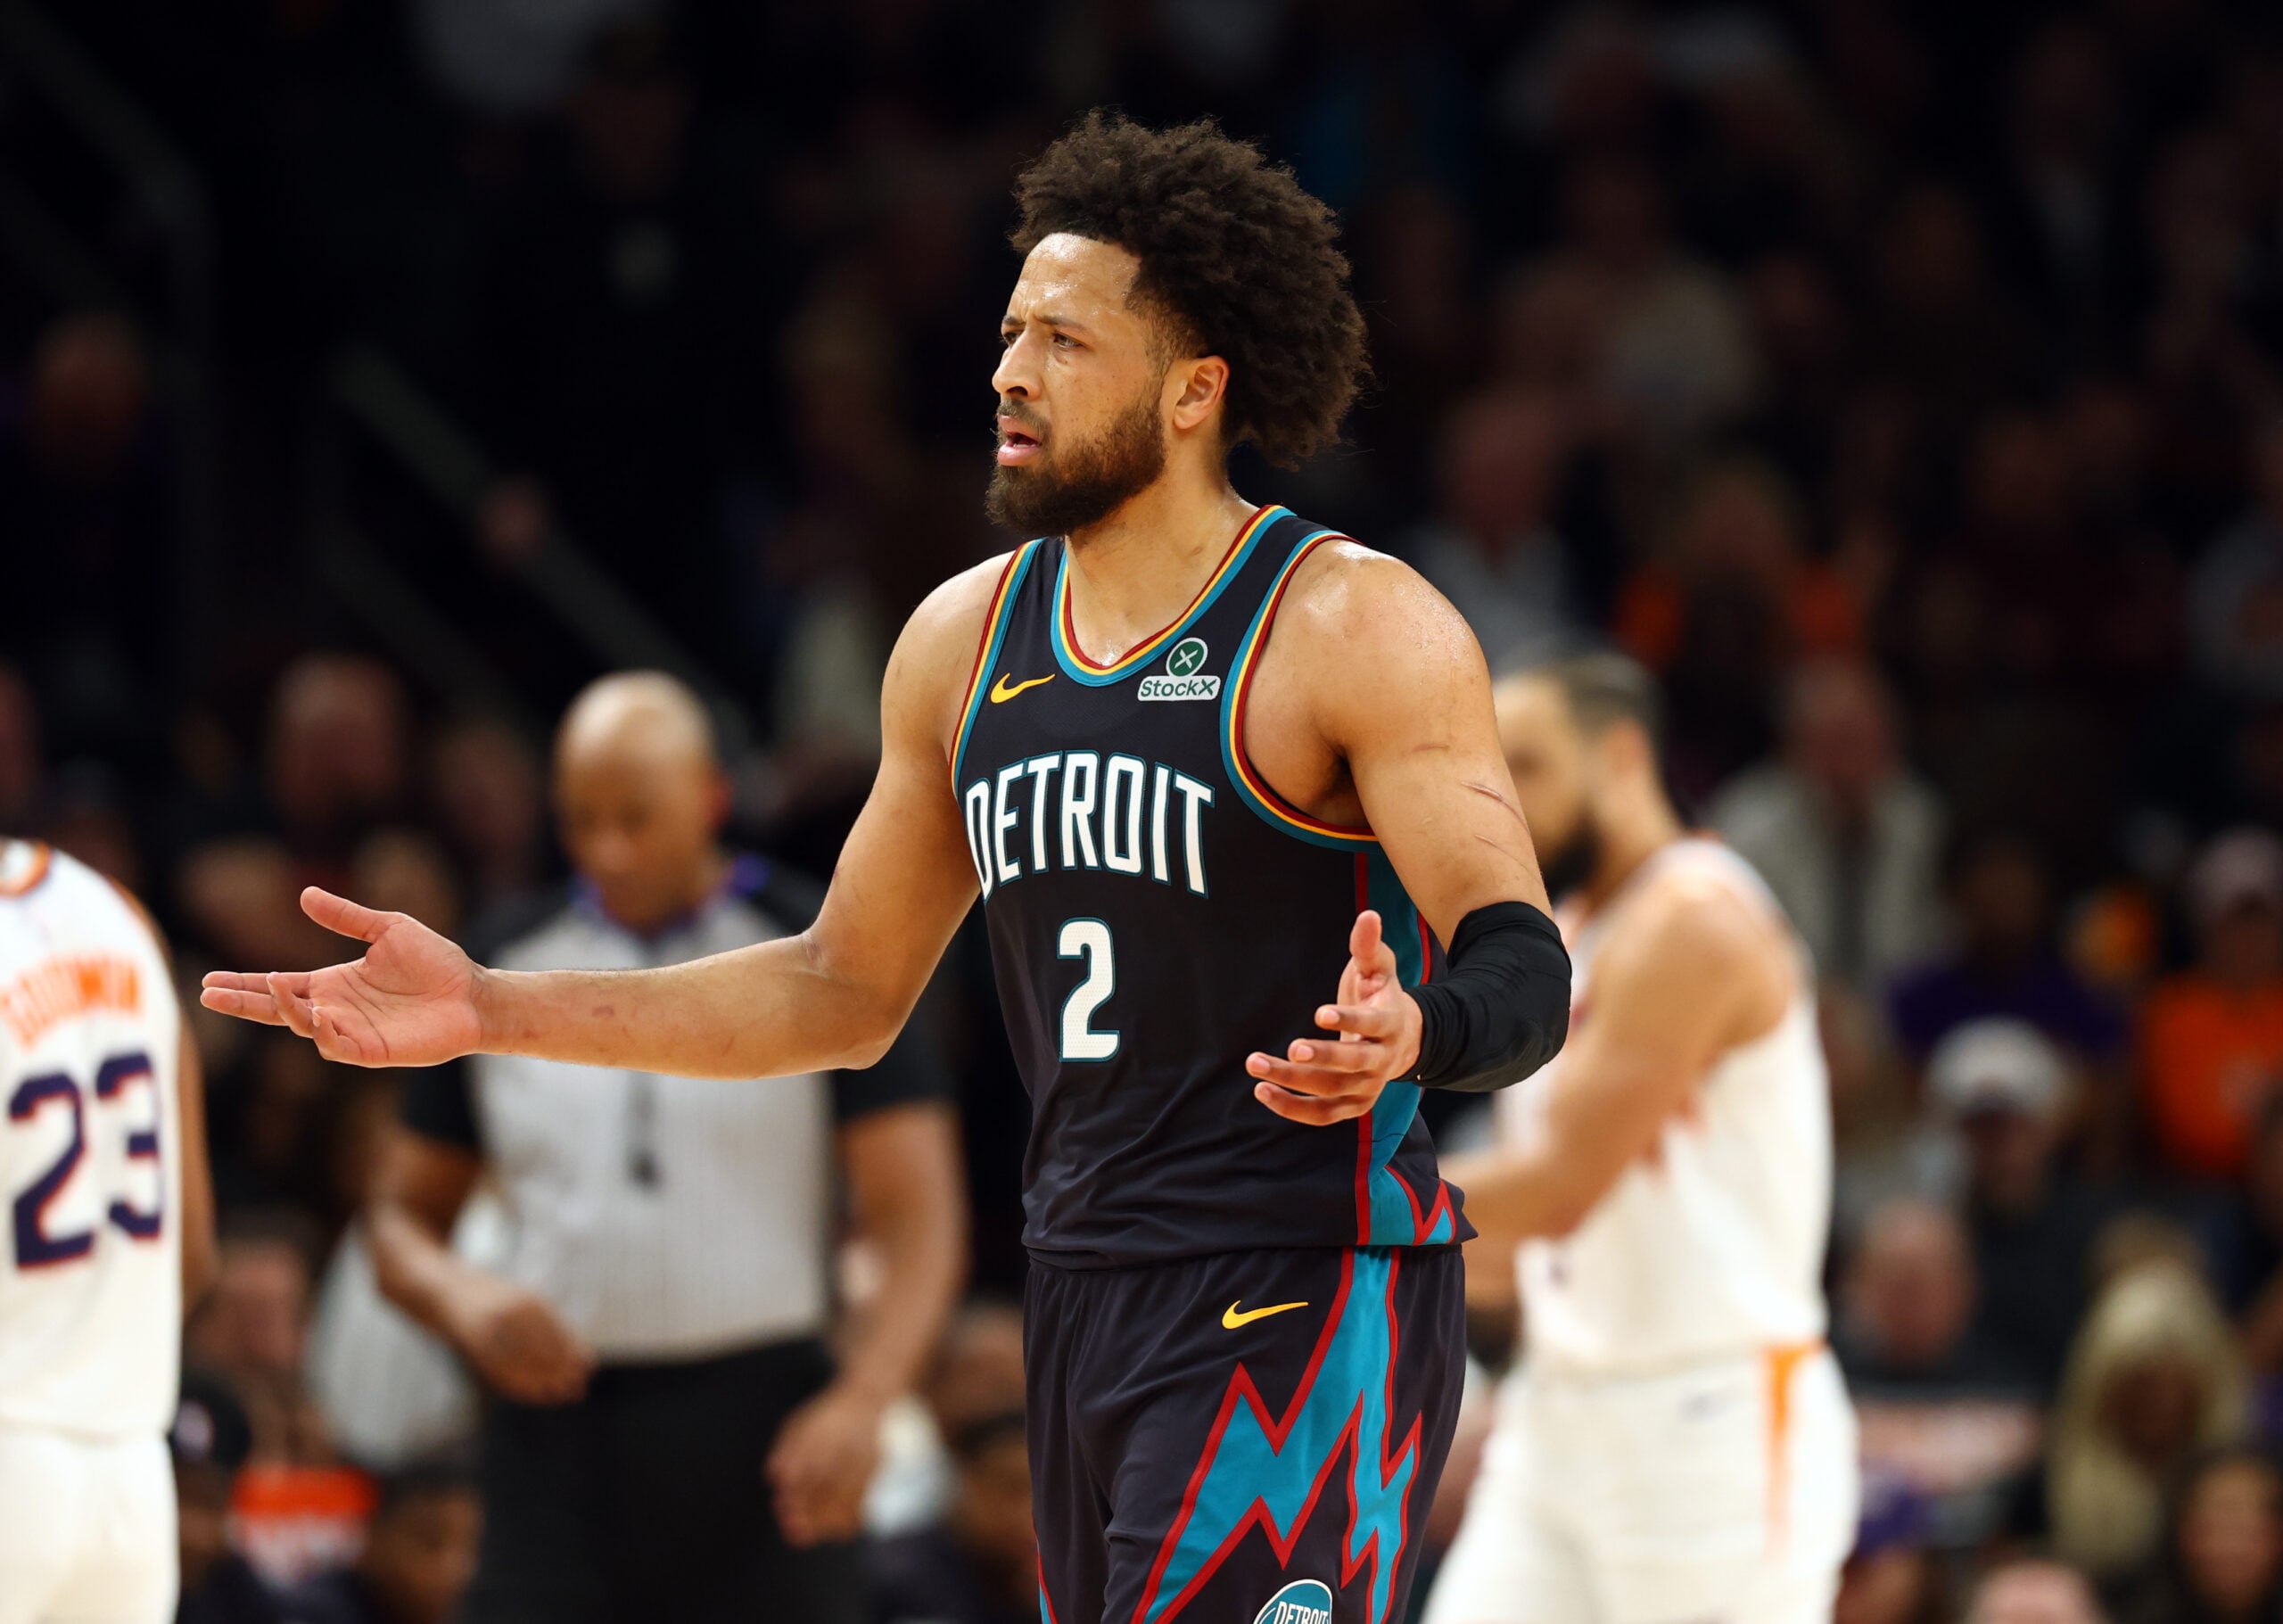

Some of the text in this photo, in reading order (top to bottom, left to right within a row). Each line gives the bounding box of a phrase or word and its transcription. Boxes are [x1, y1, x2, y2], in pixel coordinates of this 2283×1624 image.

[1140, 679, 1217, 697] StockX
[965, 750, 1216, 903] DETROIT
[1057, 917, 1120, 1062] 2
[8, 1050, 163, 1270] 23
